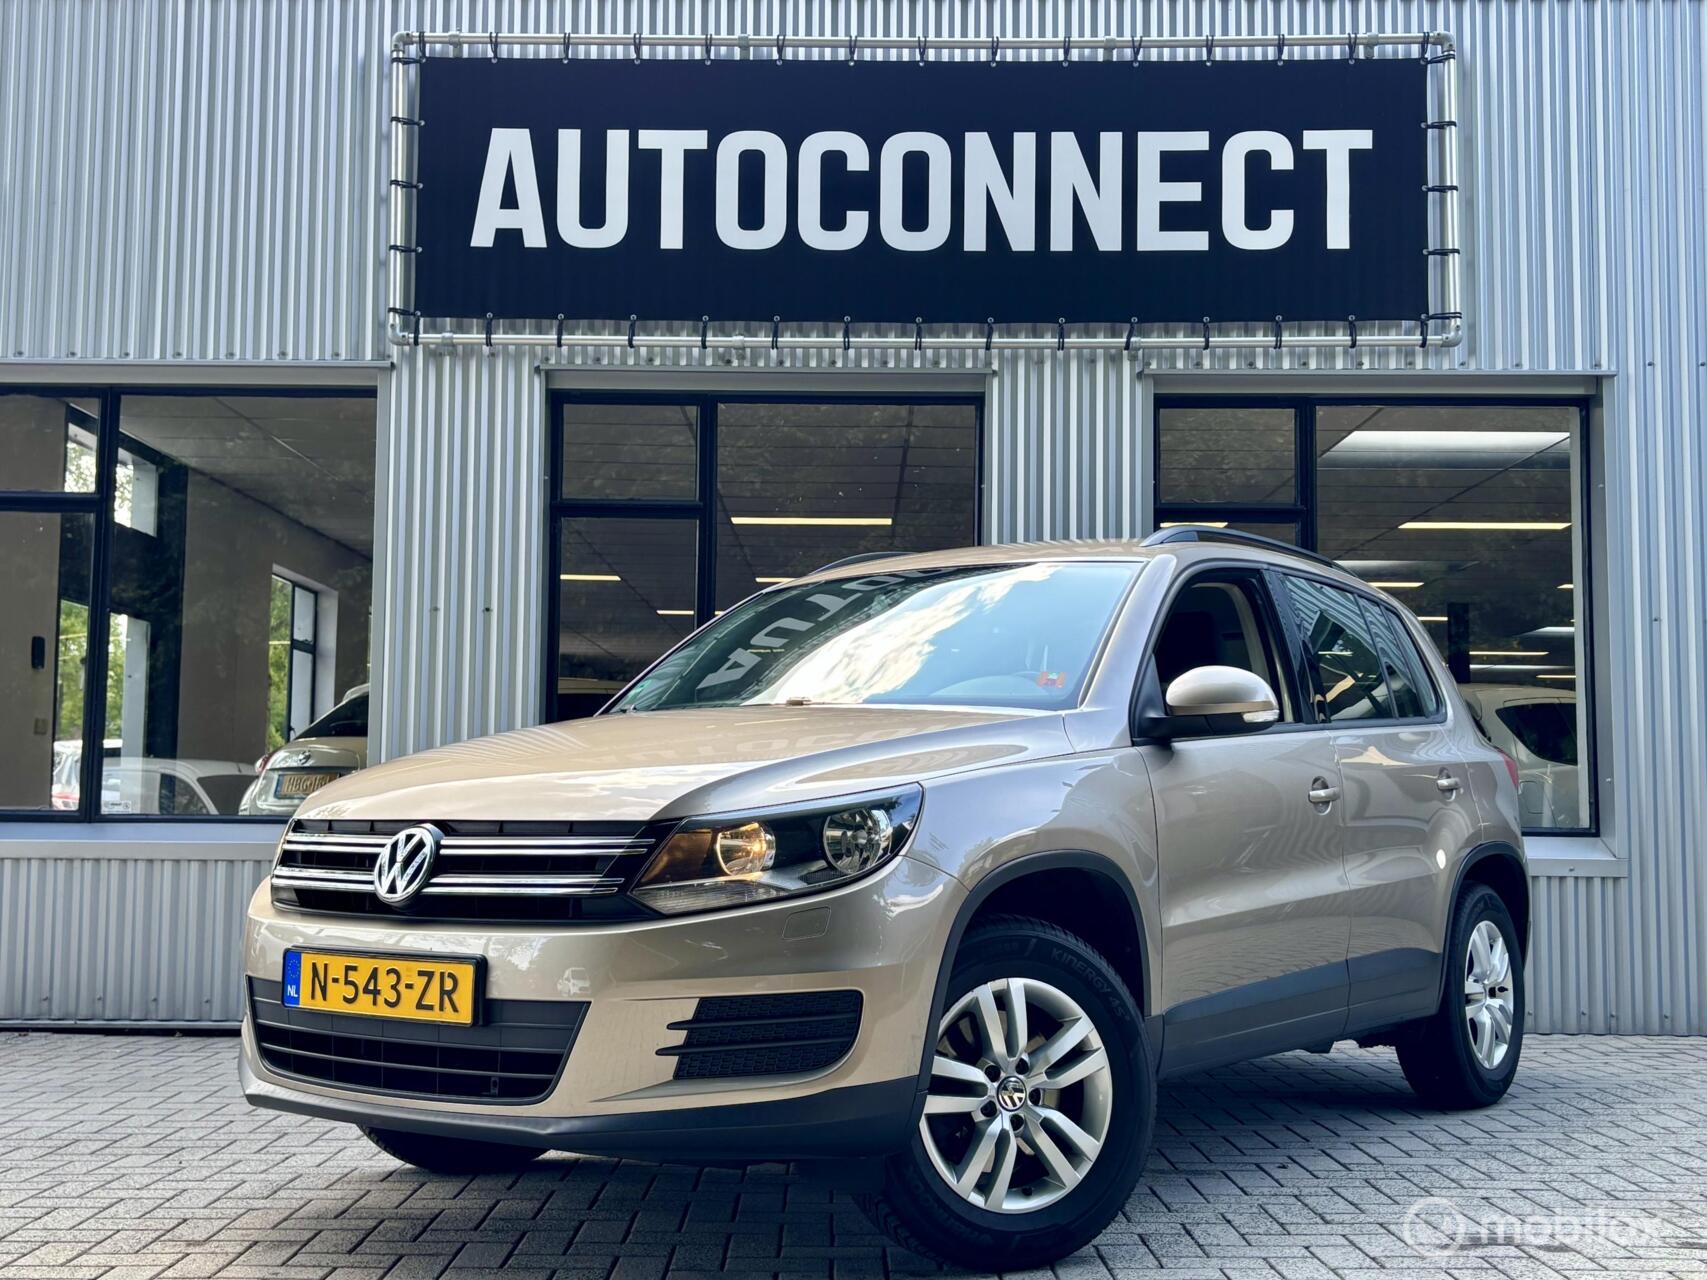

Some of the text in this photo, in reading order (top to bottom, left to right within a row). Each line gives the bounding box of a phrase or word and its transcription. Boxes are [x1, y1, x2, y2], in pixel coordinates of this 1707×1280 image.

[470, 127, 1374, 252] AUTOCONNECT
[286, 984, 299, 998] NL
[310, 961, 461, 1014] N-543-ZR
[1050, 947, 1112, 993] KINERGY
